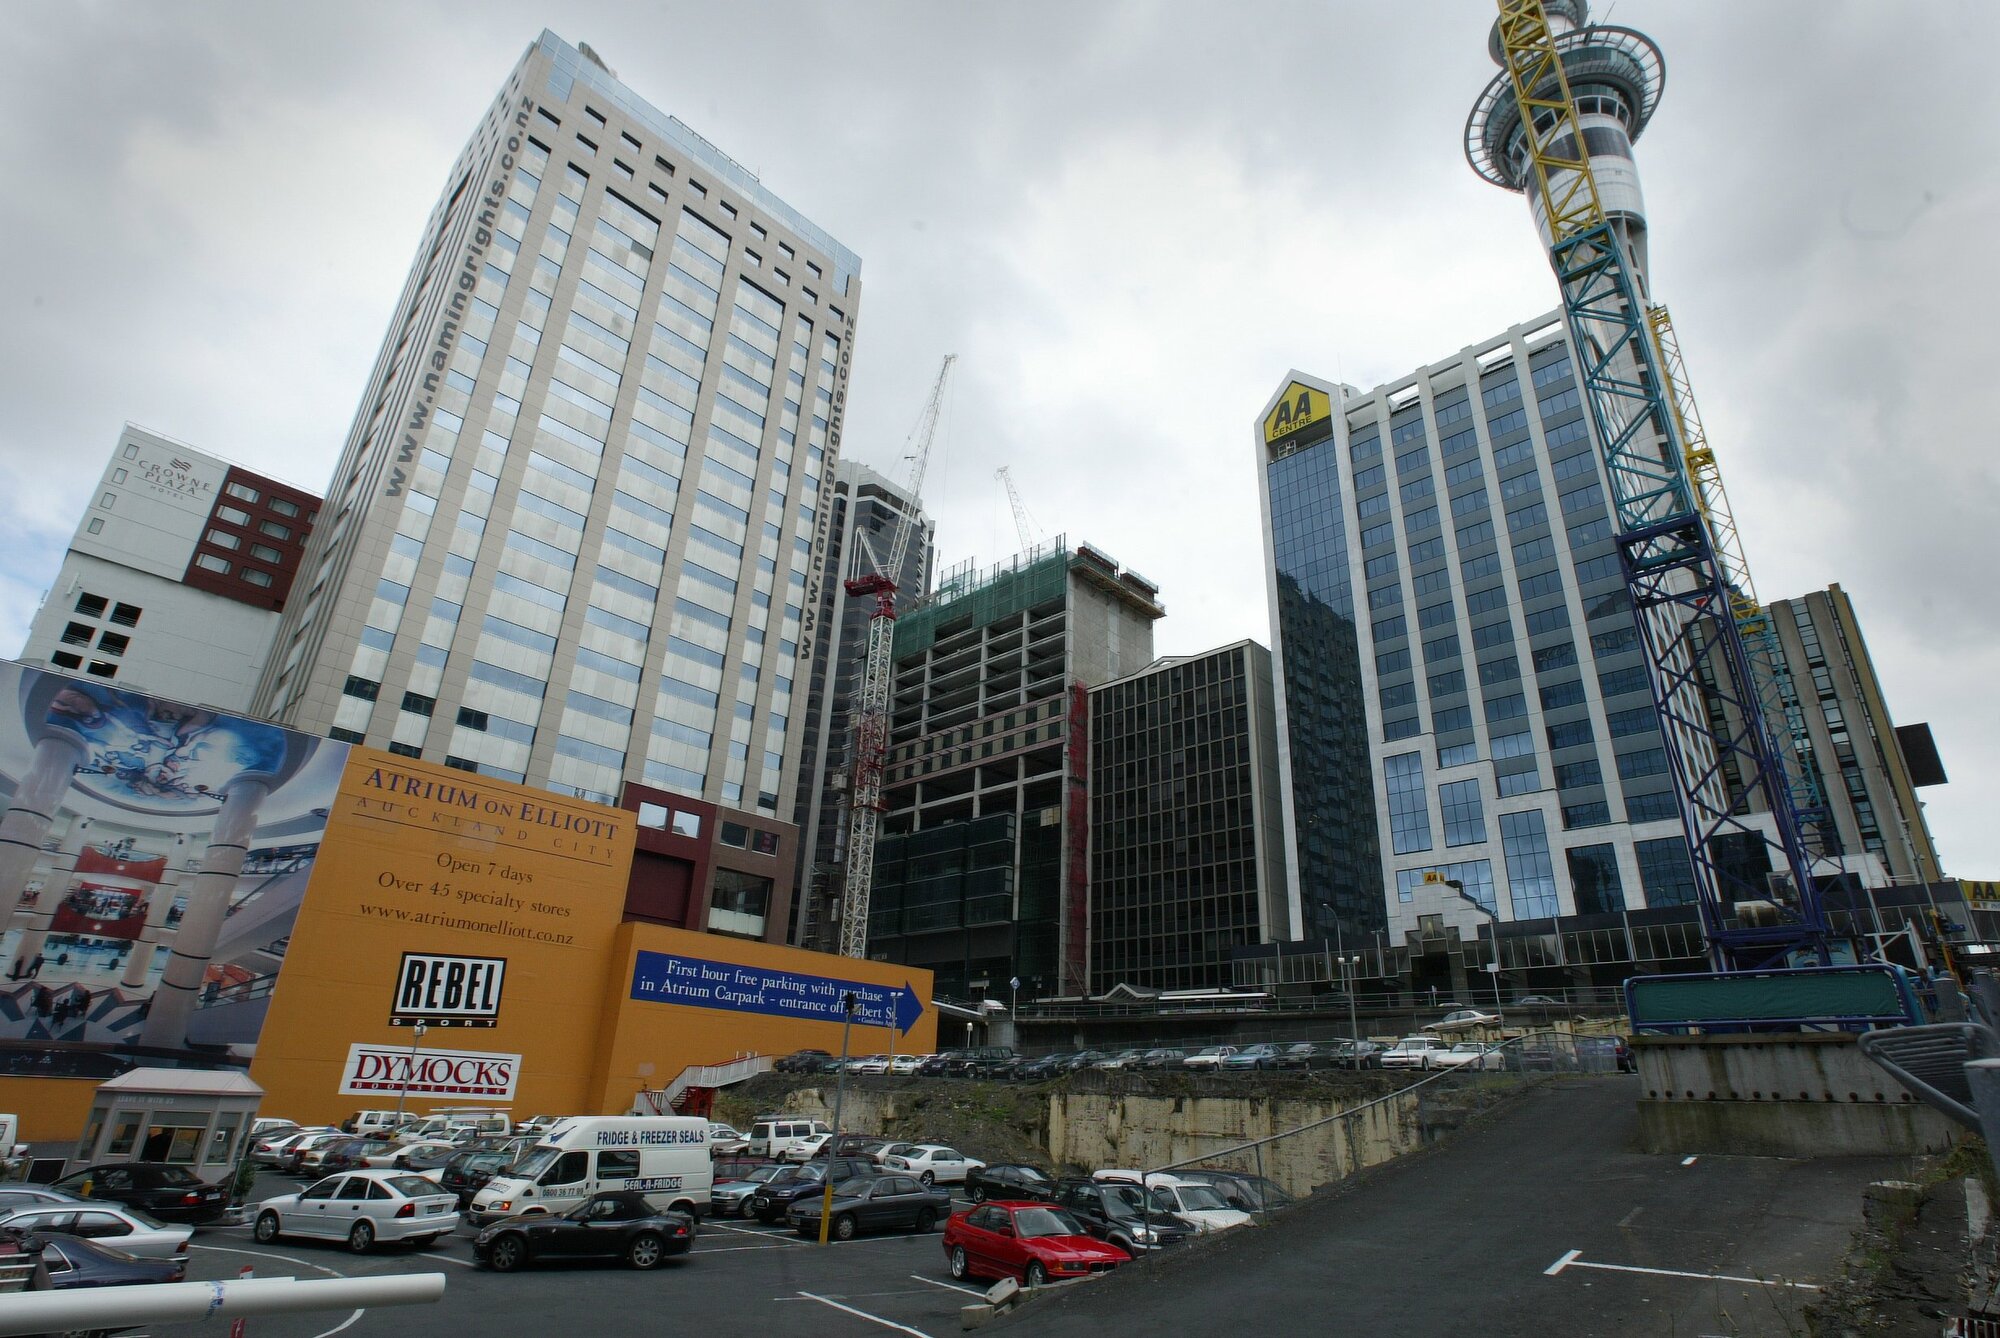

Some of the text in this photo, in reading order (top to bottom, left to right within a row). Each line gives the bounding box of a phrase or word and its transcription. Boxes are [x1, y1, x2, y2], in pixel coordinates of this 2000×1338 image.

[386, 96, 534, 498] www.namingrights.co.nz
[1272, 391, 1311, 430] AA
[1272, 415, 1312, 438] CENTRE
[138, 460, 209, 491] CROWNE
[145, 471, 196, 495] PLAZA
[150, 485, 185, 500] HOTEL
[801, 315, 855, 660] www.namingrights.co.nz
[363, 769, 619, 840] ATRIUM ON ELLIOTT
[356, 796, 614, 859] AUCKLAND CITY
[436, 851, 534, 884] Open 7 days
[378, 871, 571, 918] Over 45 specialty stores
[1972, 881, 1998, 899] AA
[360, 902, 574, 945] www.atriumonelliott.co.nz
[401, 959, 495, 1011] REBEL
[667, 959, 698, 977] First
[702, 965, 731, 982] hour
[735, 969, 758, 986] free
[762, 973, 807, 996] parking
[811, 980, 836, 996] with
[640, 976, 655, 992] in
[660, 978, 710, 998] Atrium
[715, 985, 765, 1006] Carpark
[779, 996, 827, 1012] entrance
[830, 1000, 846, 1013] off
[846, 1003, 881, 1018] lbert
[392, 1018, 494, 1027] SPORT
[353, 1054, 512, 1086] DYMOCKS
[597, 1130, 704, 1146] FRIDGE & FREEZER SEALS
[624, 1178, 682, 1191] SEAL-A-FRIDGE
